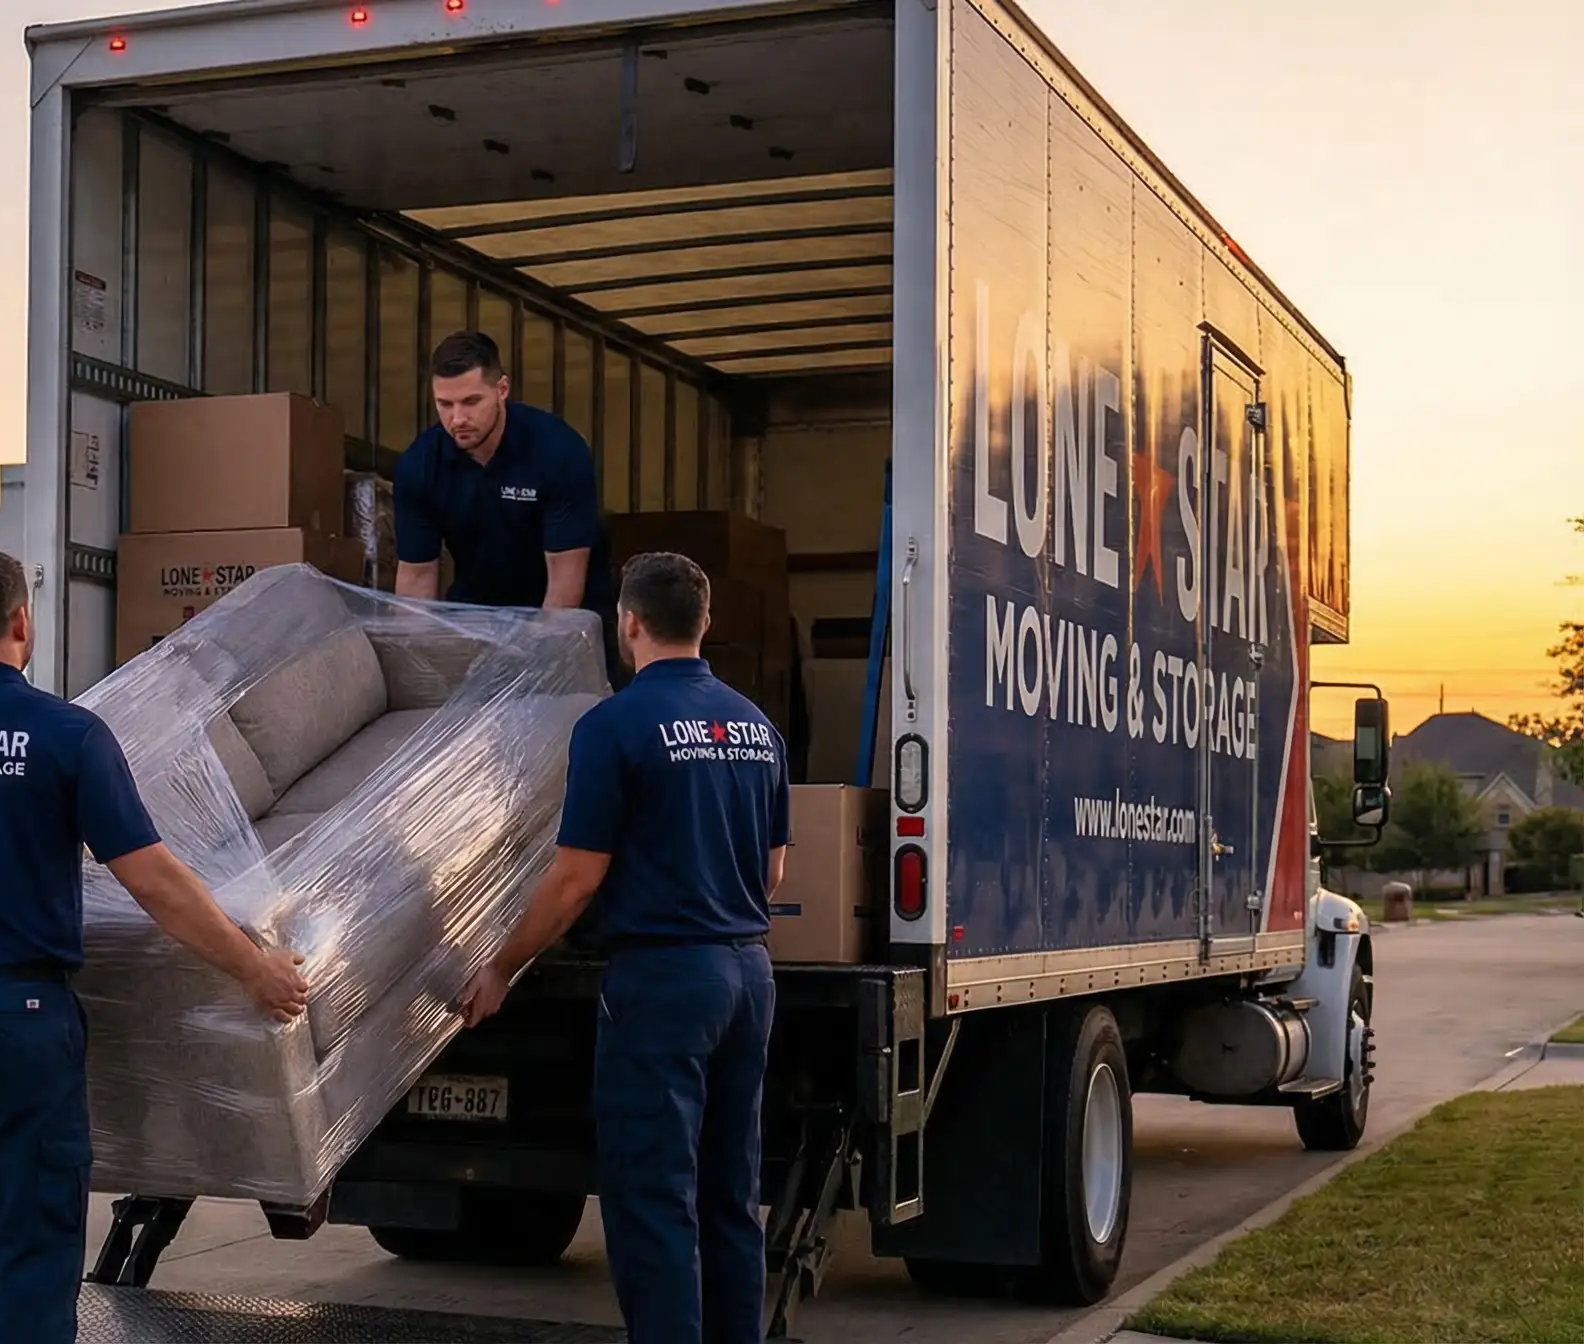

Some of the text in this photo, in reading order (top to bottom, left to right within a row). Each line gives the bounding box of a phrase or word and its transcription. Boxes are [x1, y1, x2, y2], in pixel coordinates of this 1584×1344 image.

[974, 278, 1269, 647] LONE STAR
[161, 566, 201, 586] LONE
[986, 594, 1256, 761] MOVING & STORAGE
[659, 719, 773, 748] LONE STAR
[1074, 787, 1196, 844] www.lonestar.com
